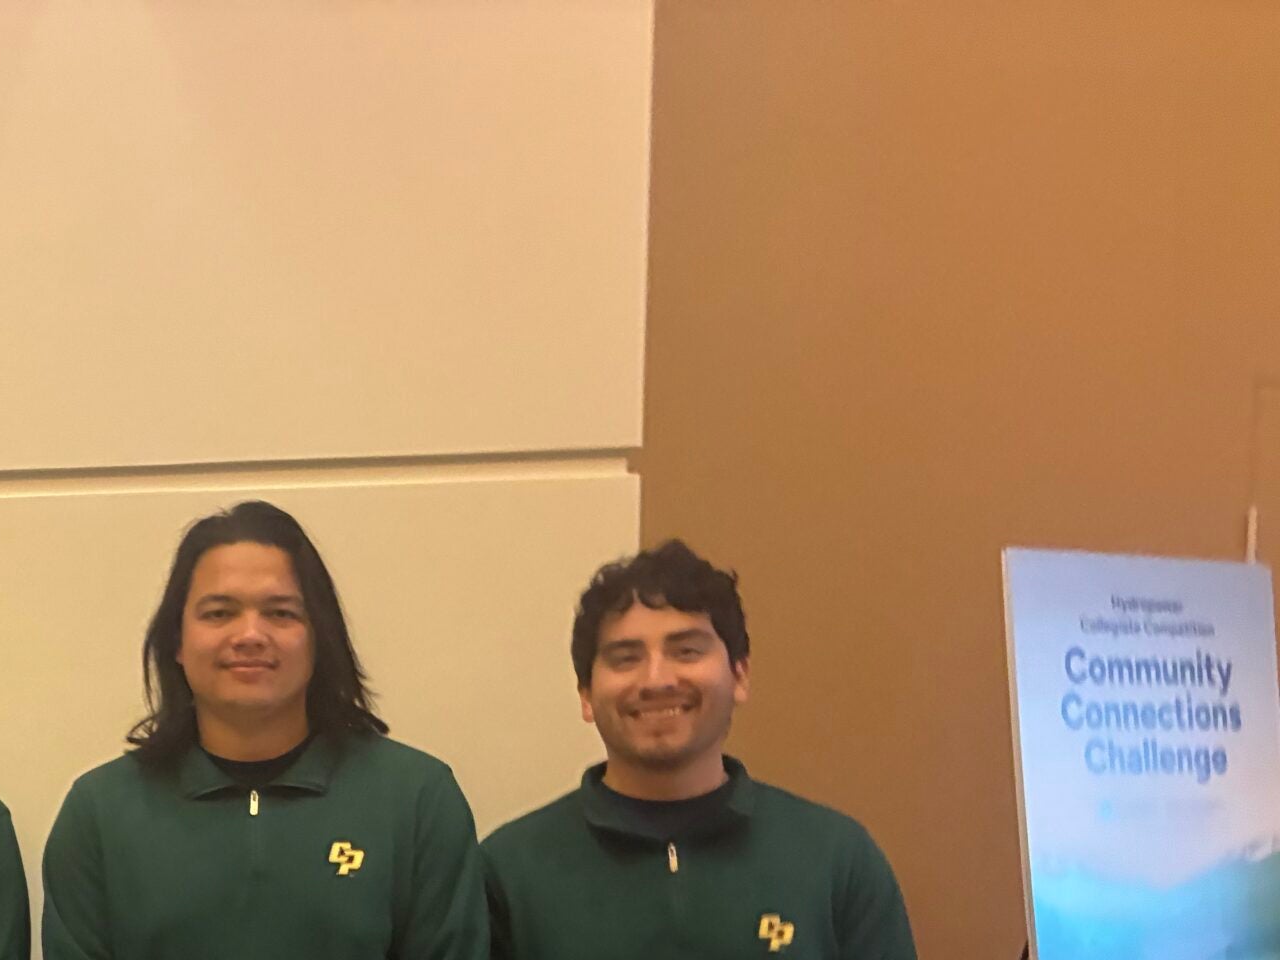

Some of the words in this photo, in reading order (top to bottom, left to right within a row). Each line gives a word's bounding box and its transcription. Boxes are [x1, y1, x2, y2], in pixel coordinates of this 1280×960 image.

[1064, 646, 1233, 695] Community
[1060, 690, 1242, 732] Connections
[1084, 737, 1229, 784] Challenge
